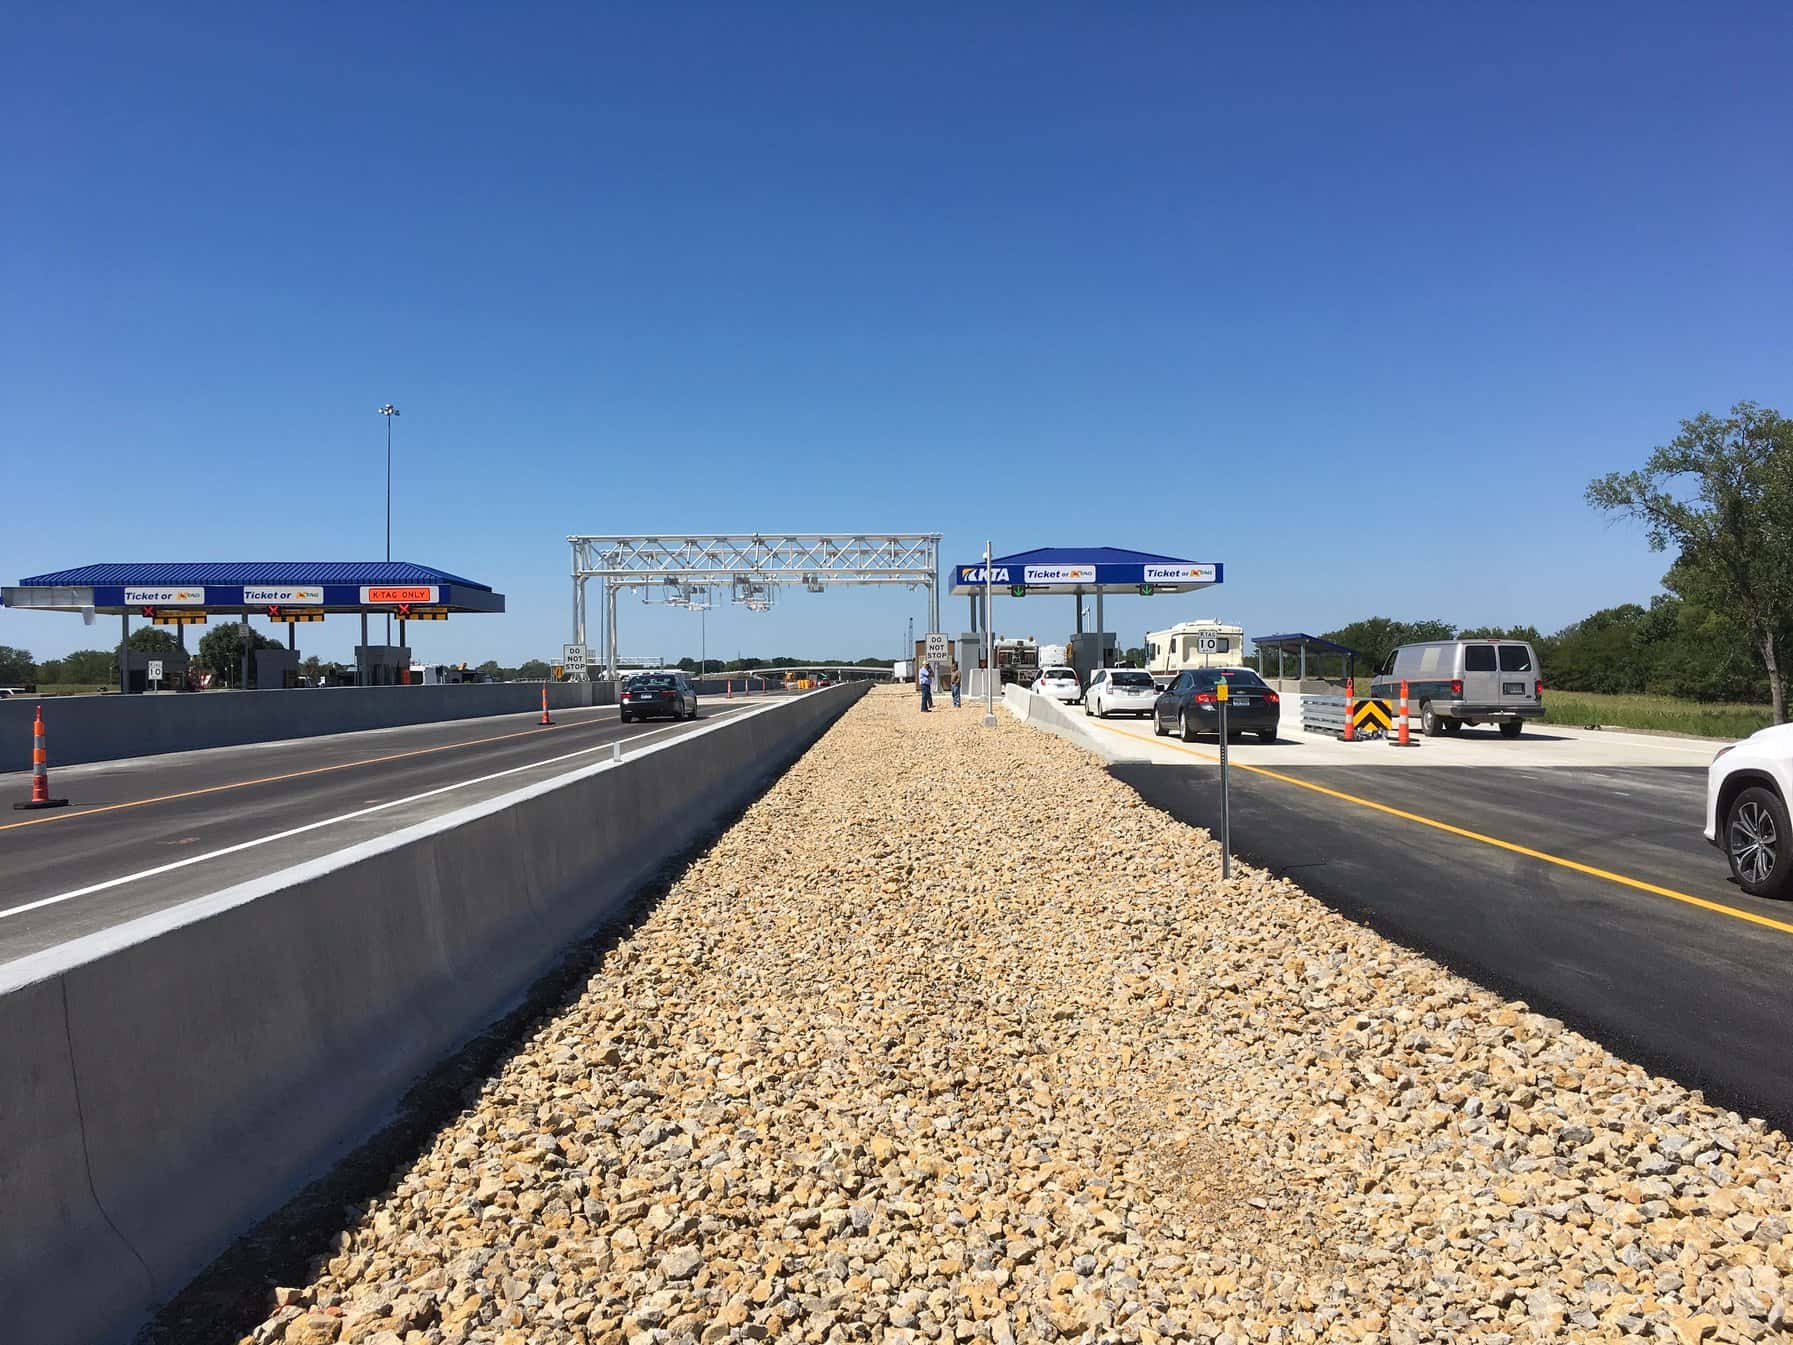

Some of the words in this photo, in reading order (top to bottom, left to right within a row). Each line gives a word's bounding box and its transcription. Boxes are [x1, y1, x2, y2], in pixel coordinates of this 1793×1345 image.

[1028, 570, 1060, 578] Ticket
[1147, 569, 1180, 577] Ticket
[126, 592, 159, 600] Ticket
[245, 591, 278, 599] Ticket
[1200, 639, 1215, 649] 10
[150, 668, 161, 676] 10
